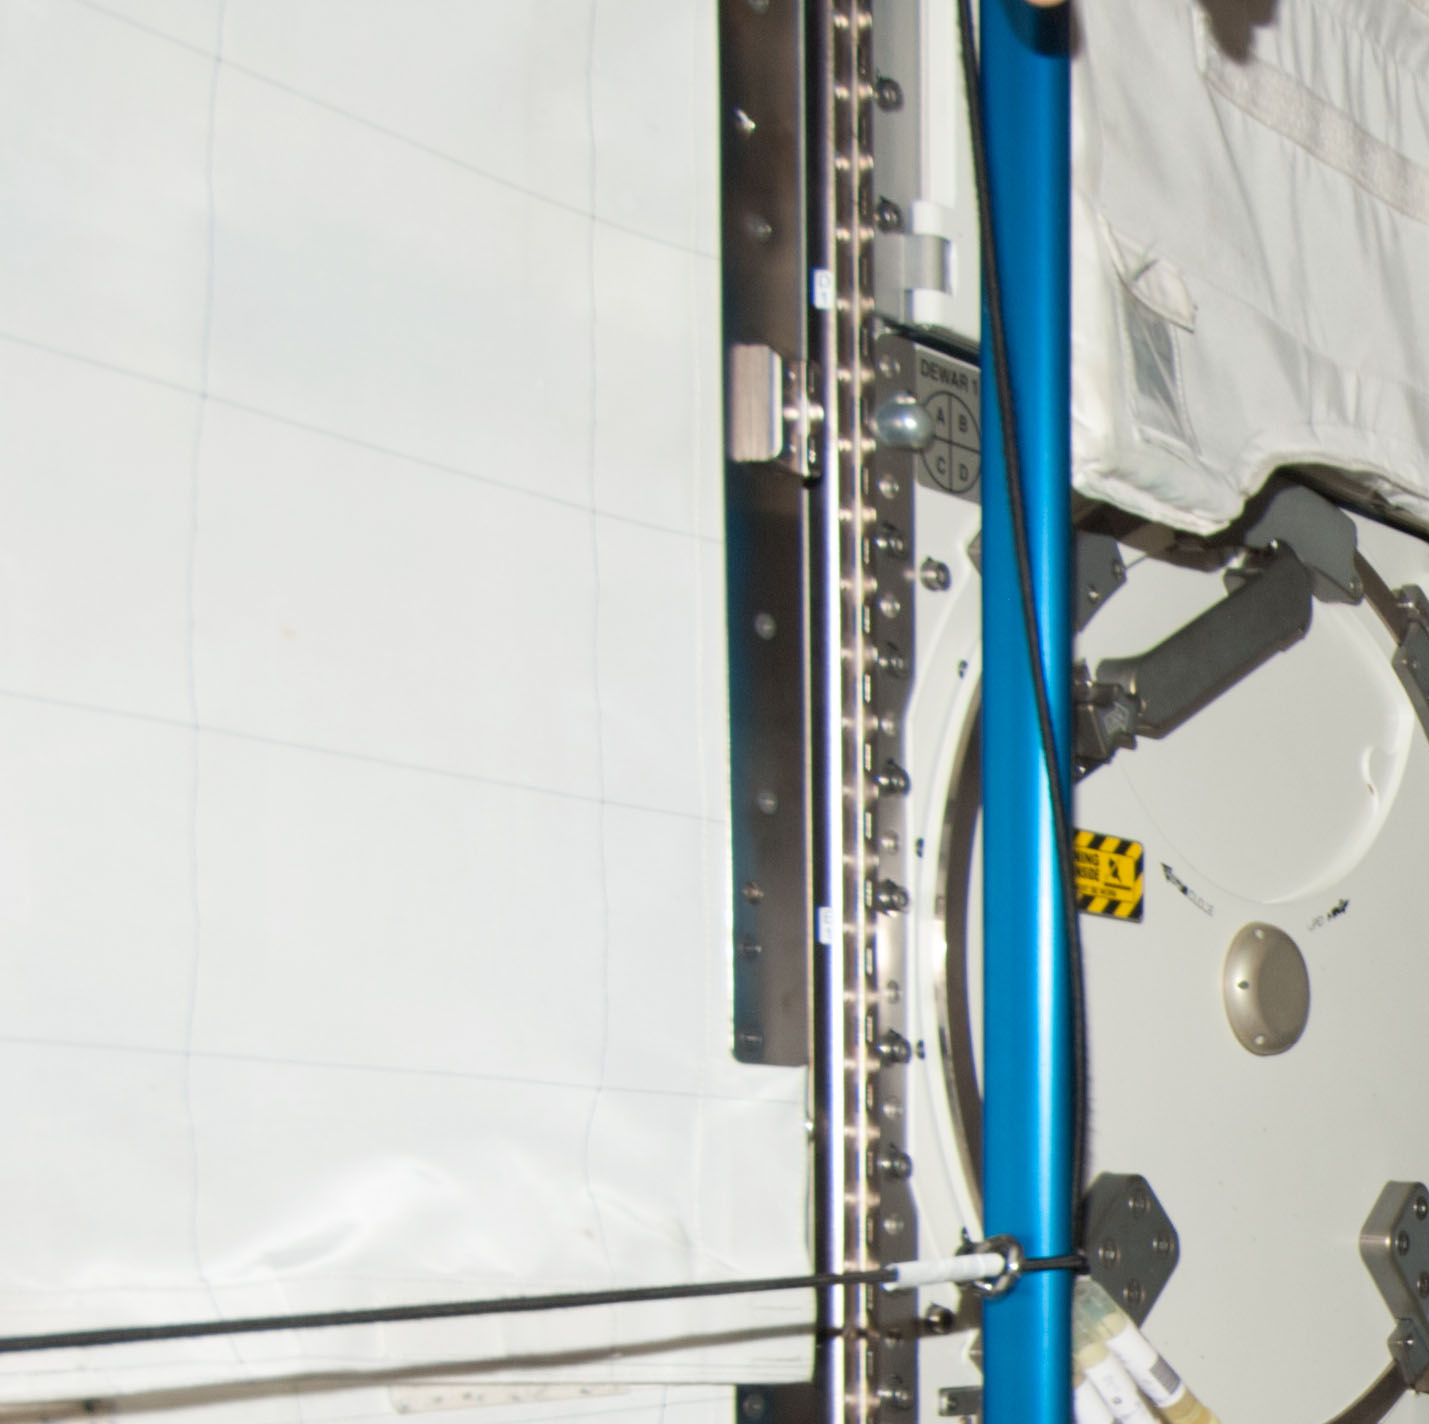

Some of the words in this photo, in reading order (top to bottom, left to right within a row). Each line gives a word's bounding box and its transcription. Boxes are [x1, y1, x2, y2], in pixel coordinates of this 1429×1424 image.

[920, 357, 970, 392] DEWAR
[935, 407, 946, 427] A
[958, 412, 968, 433] B
[935, 454, 947, 477] C
[958, 462, 970, 484] D
[1074, 850, 1100, 867] NING
[1075, 865, 1100, 882] NSIDE
